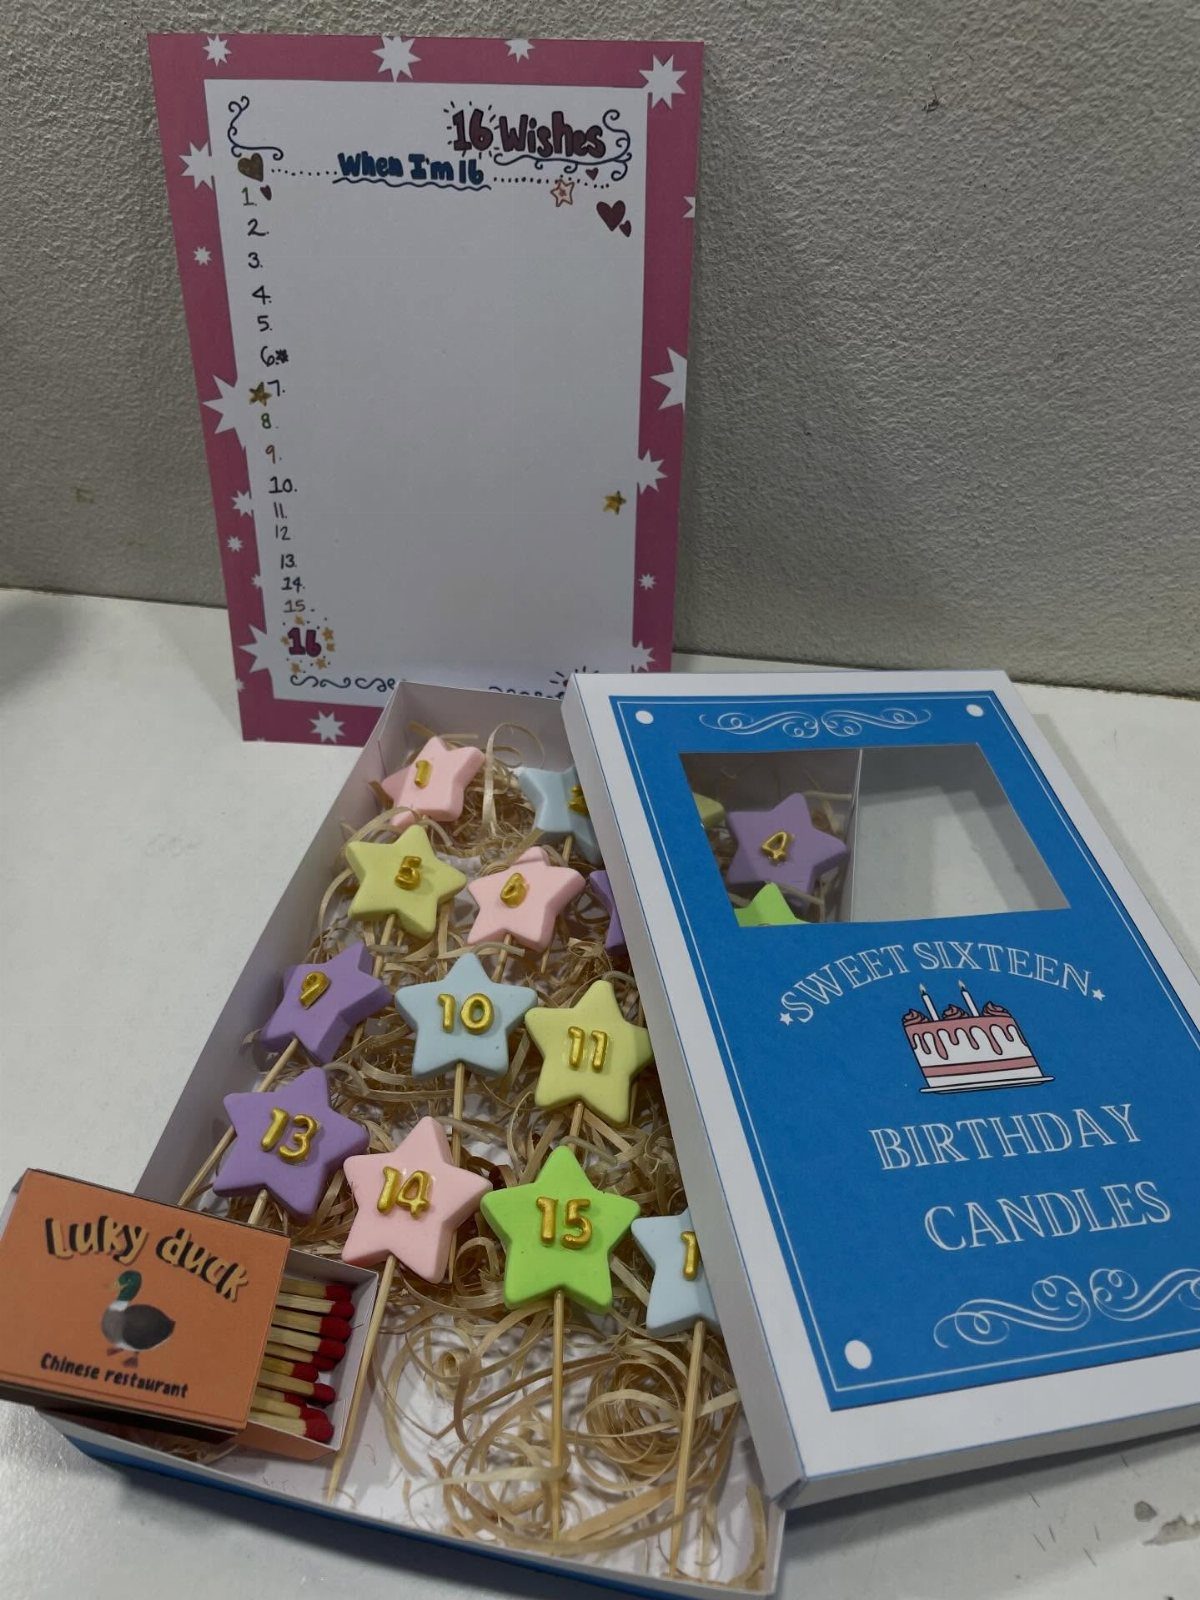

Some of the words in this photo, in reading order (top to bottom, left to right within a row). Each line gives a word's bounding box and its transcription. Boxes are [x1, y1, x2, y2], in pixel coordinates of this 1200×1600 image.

[451, 108, 494, 151] 16
[499, 111, 606, 158] Wishes
[337, 151, 404, 178] When
[408, 153, 454, 181] I'm
[459, 158, 484, 185] 16
[241, 186, 257, 206] 1.
[247, 218, 270, 236] 2.
[248, 252, 263, 269] 3.
[252, 285, 272, 305] 4.
[257, 315, 272, 332] 5.
[267, 379, 285, 397] 7.
[265, 445, 282, 464] 9.
[268, 476, 298, 494] 10.
[273, 501, 288, 519] 11.
[281, 577, 305, 594] 14.
[287, 627, 322, 658] 16
[413, 759, 433, 789] 1
[761, 831, 788, 864] 4
[394, 855, 423, 891] 5
[299, 971, 330, 1008] 9
[780, 943, 909, 1023] SWEET
[912, 941, 1092, 996] SIXTEEN
[437, 992, 495, 1037] 10
[567, 1025, 610, 1074] 11
[260, 1107, 320, 1164] 13
[868, 1102, 1142, 1172] BIRTHDAY
[376, 1166, 434, 1221] 14
[536, 1196, 593, 1251] 15
[922, 1180, 1173, 1252] CANDLES
[155, 1227, 249, 1304] duck
[40, 1353, 99, 1381] Chinese
[104, 1368, 188, 1399] restaurant
